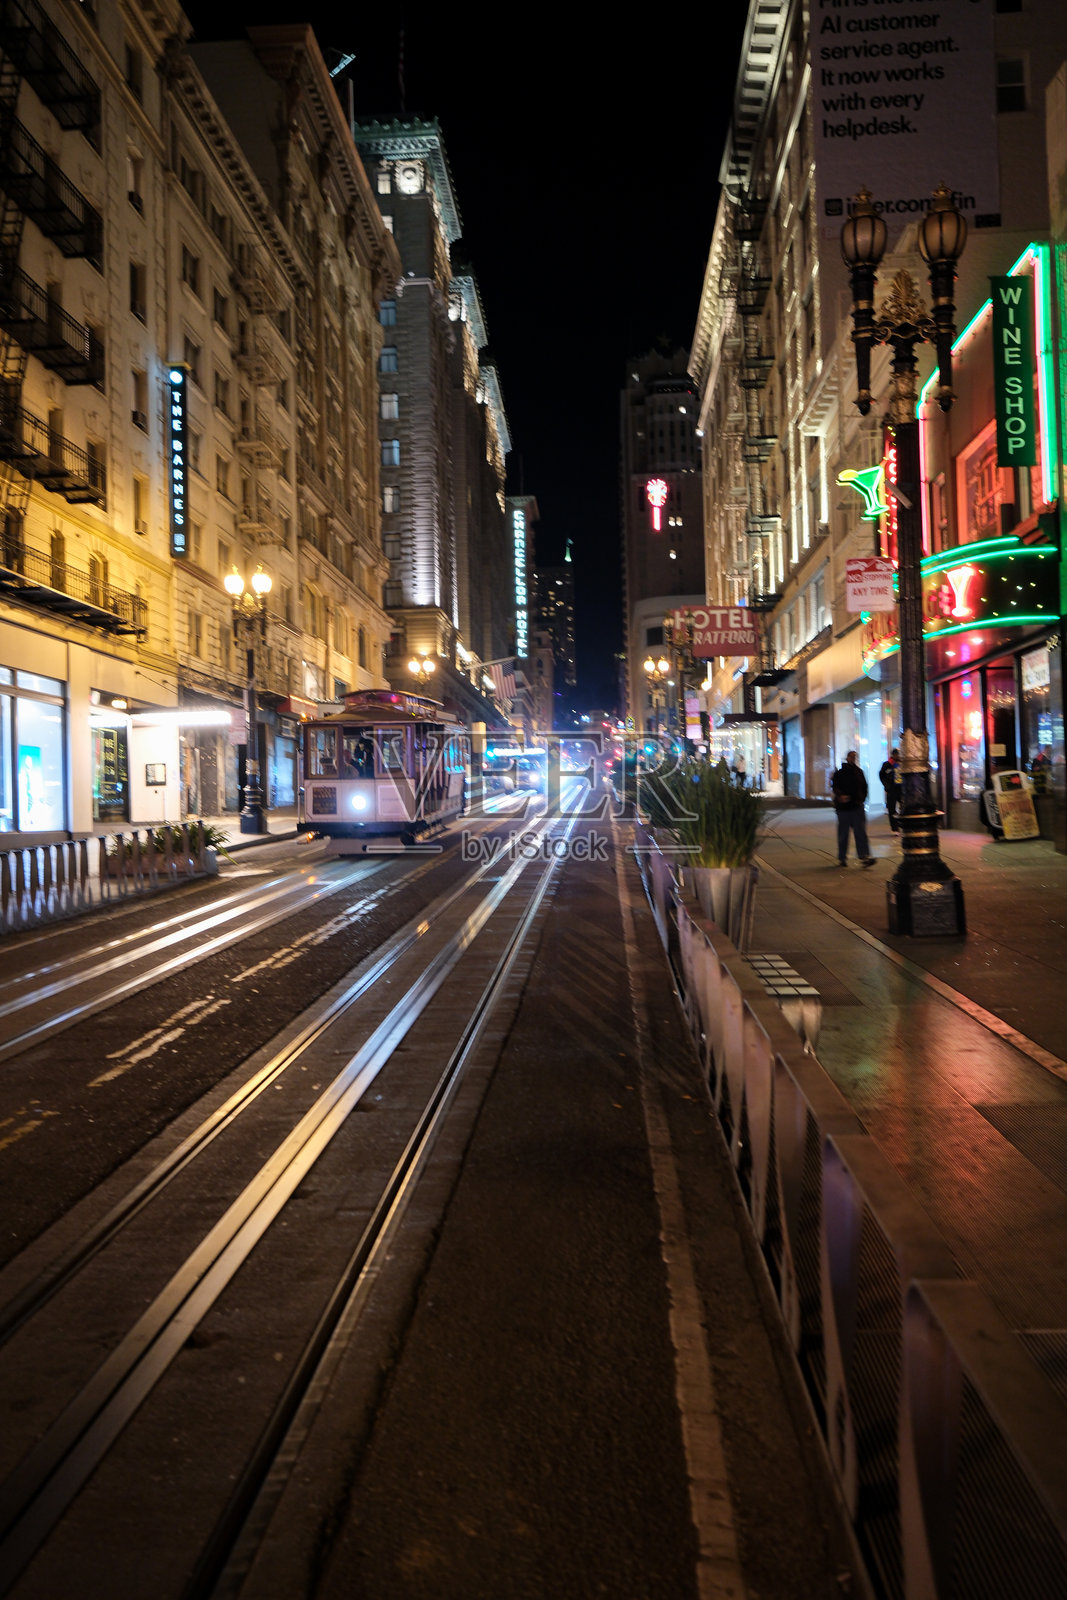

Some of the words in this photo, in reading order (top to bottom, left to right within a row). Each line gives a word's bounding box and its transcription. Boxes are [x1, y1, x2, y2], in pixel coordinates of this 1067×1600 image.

[820, 16, 841, 35] AI
[846, 13, 940, 33] customer
[820, 40, 893, 60] service
[897, 36, 960, 59] agent.
[821, 68, 835, 86] It
[838, 68, 881, 85] now
[885, 62, 945, 83] works
[822, 93, 866, 112] with
[870, 92, 925, 111] every
[822, 115, 918, 141] helpdesk.
[999, 287, 1023, 365] WINE
[171, 391, 183, 431] THE
[1004, 377, 1027, 455] SHOP
[172, 439, 184, 525] BARNES
[853, 587, 867, 596] ANY
[869, 586, 889, 596] TIME
[674, 608, 754, 630] HOTEL
[516, 610, 528, 659] HOTEL
